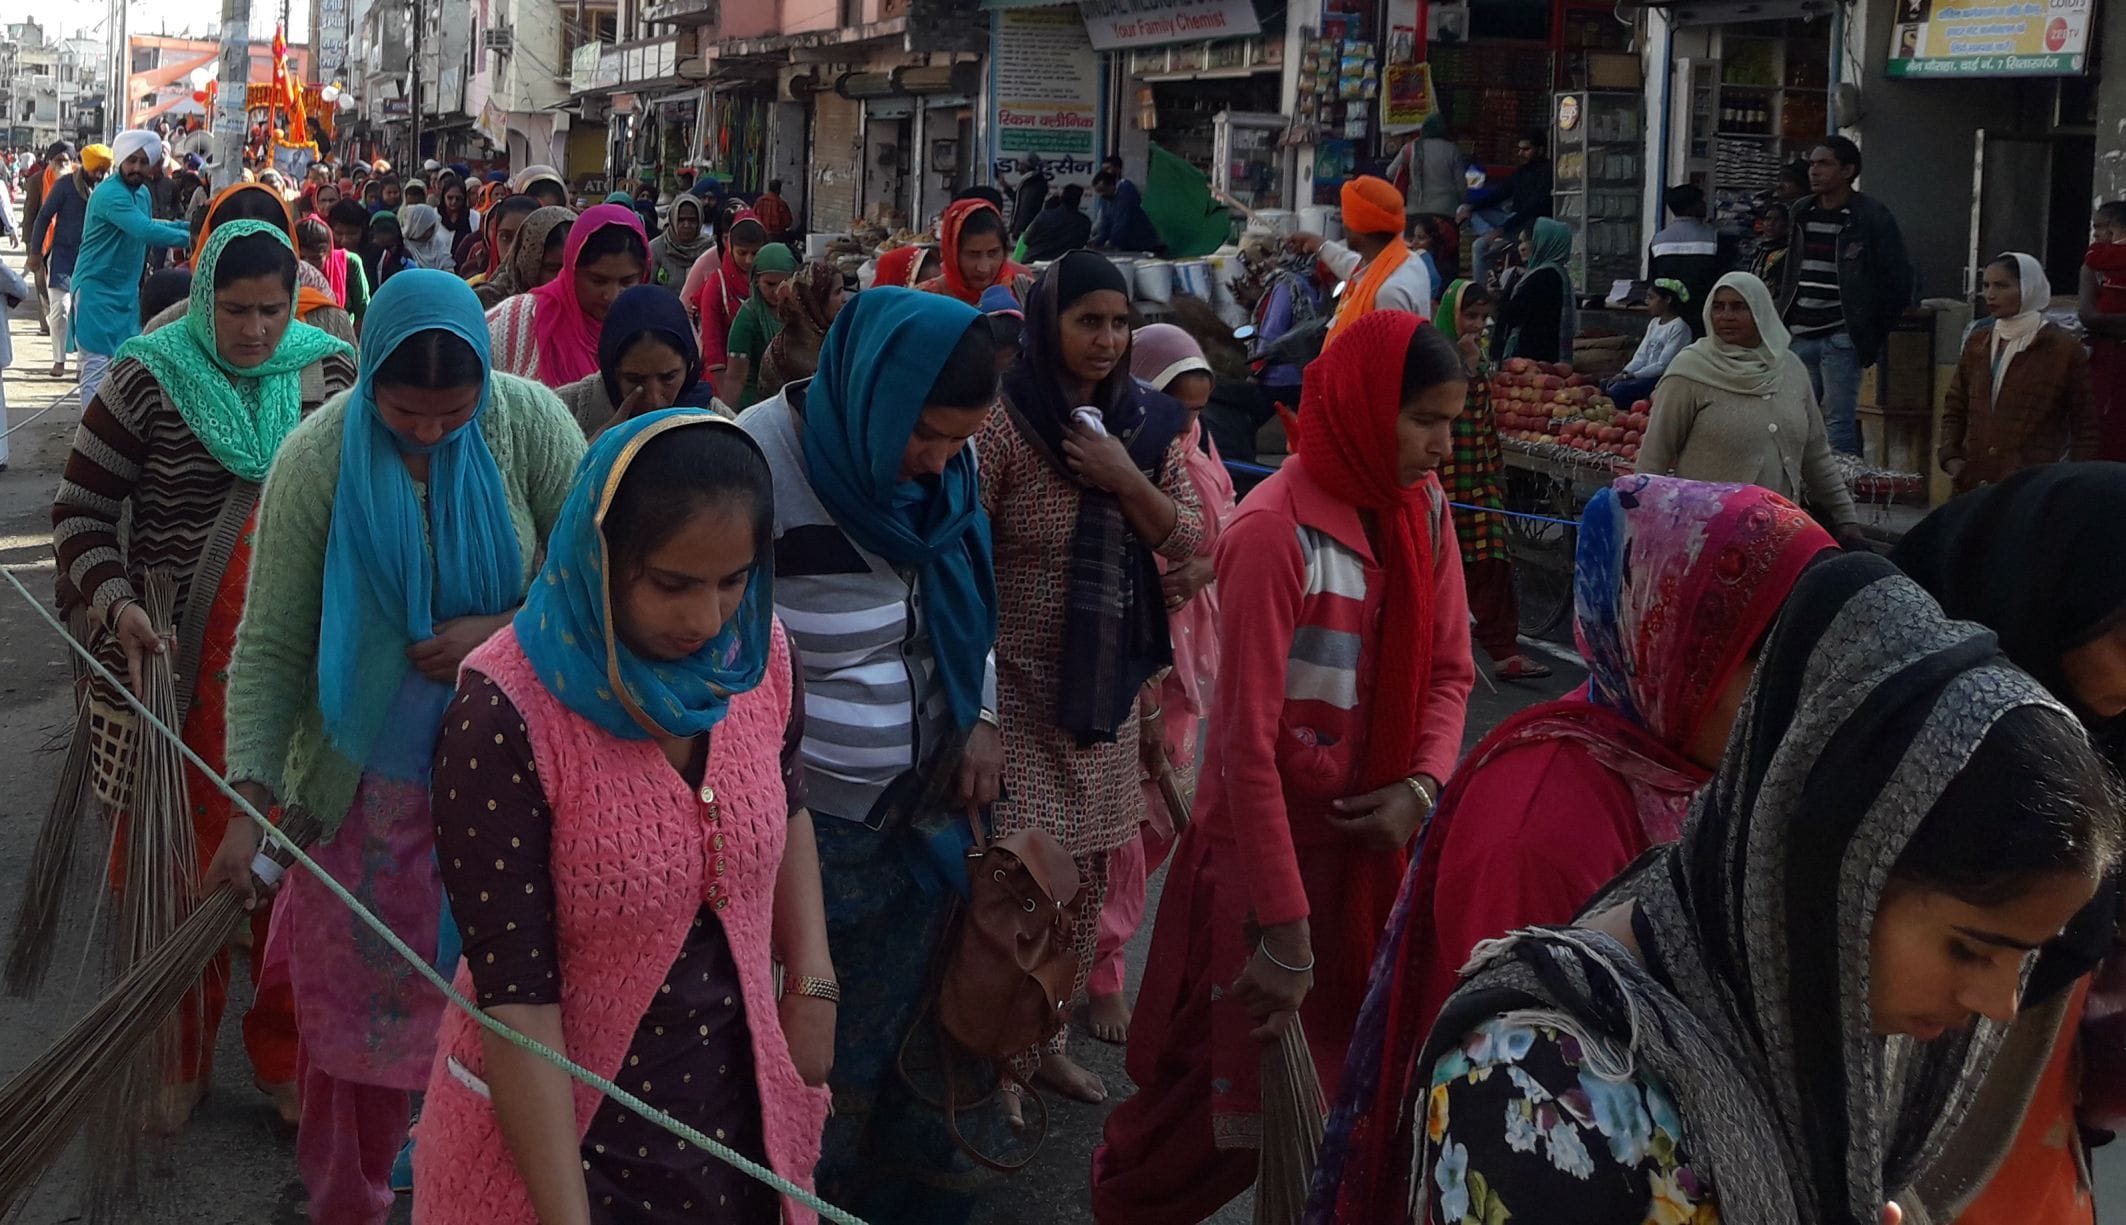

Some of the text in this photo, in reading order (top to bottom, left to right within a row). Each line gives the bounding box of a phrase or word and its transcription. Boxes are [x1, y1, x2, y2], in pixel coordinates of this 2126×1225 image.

[1111, 10, 1227, 39] Your Family Chemist
